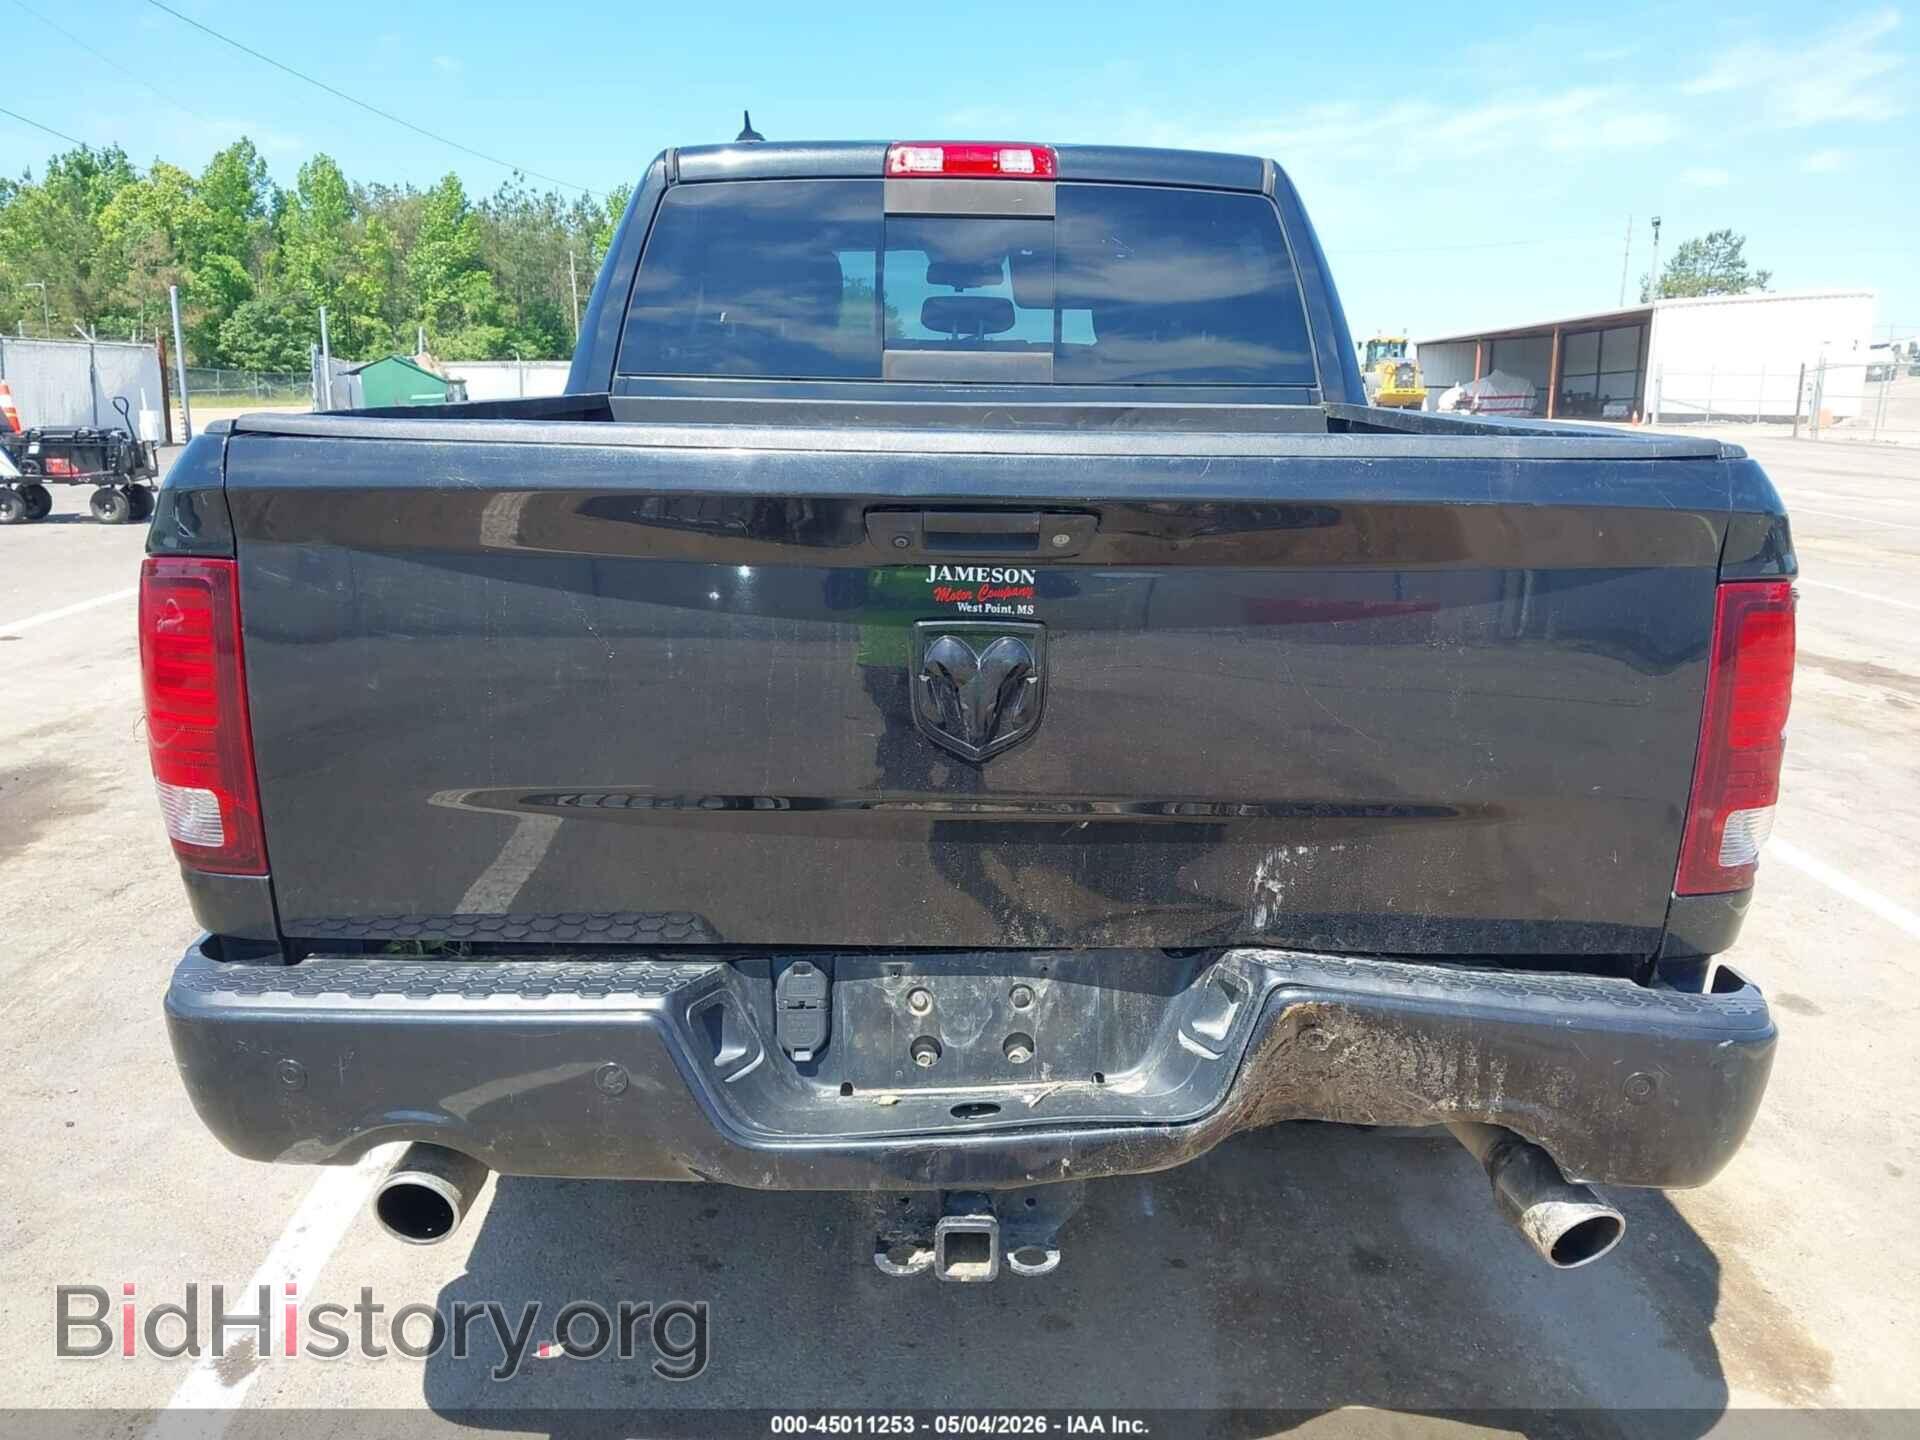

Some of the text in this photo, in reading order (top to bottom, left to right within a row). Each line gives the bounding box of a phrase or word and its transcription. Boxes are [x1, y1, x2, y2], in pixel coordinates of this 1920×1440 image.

[926, 565, 1035, 584] JAMESON
[957, 602, 1034, 615] West Point, MS
